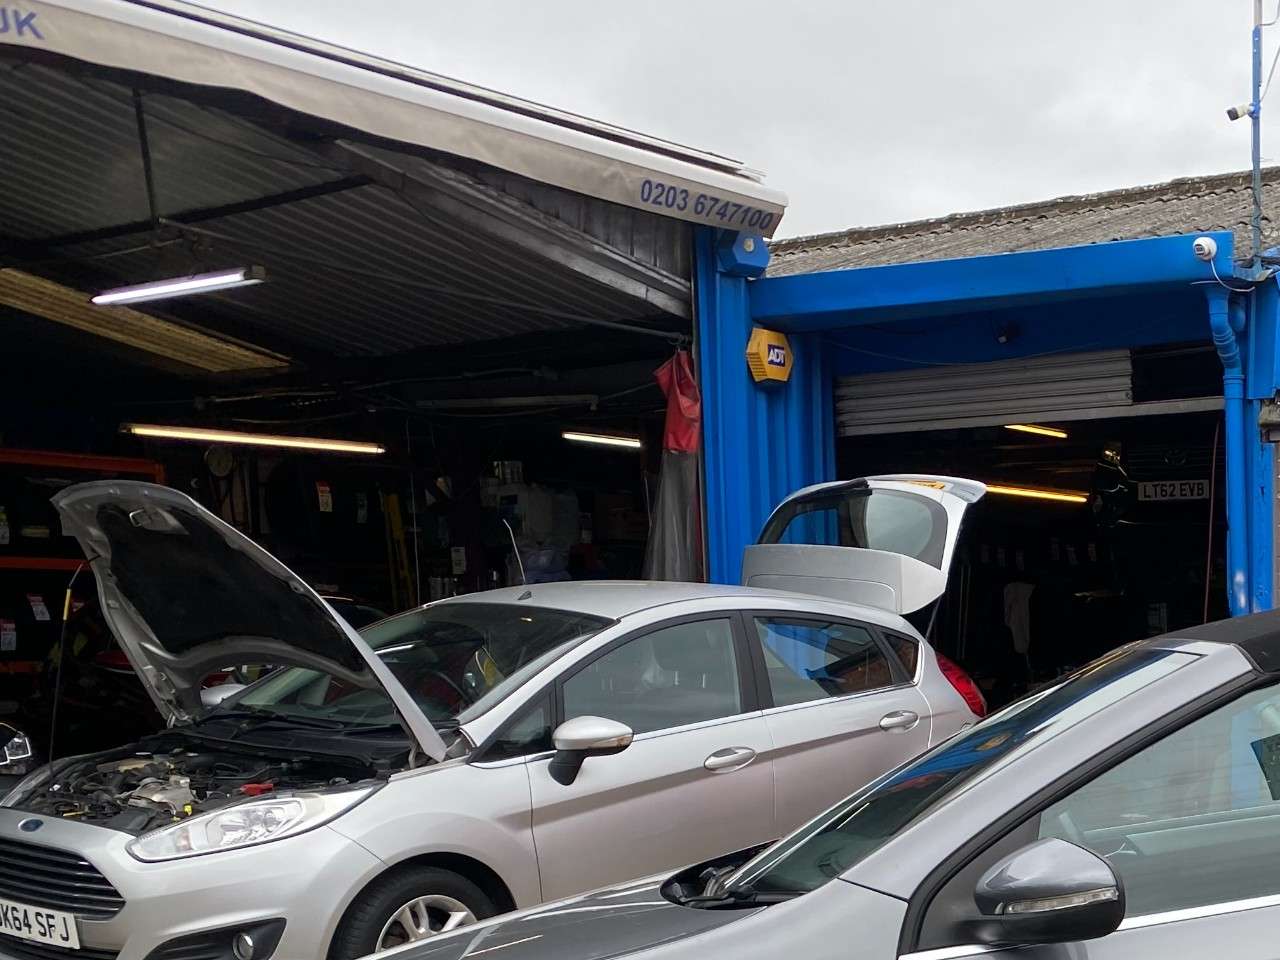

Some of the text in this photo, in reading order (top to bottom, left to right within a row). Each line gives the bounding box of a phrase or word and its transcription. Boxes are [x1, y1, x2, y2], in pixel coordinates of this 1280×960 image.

[641, 179, 773, 229] 0203 6747100
[768, 348, 785, 364] ADT
[1144, 483, 1176, 498] LT62
[35, 912, 69, 942] SFJ
